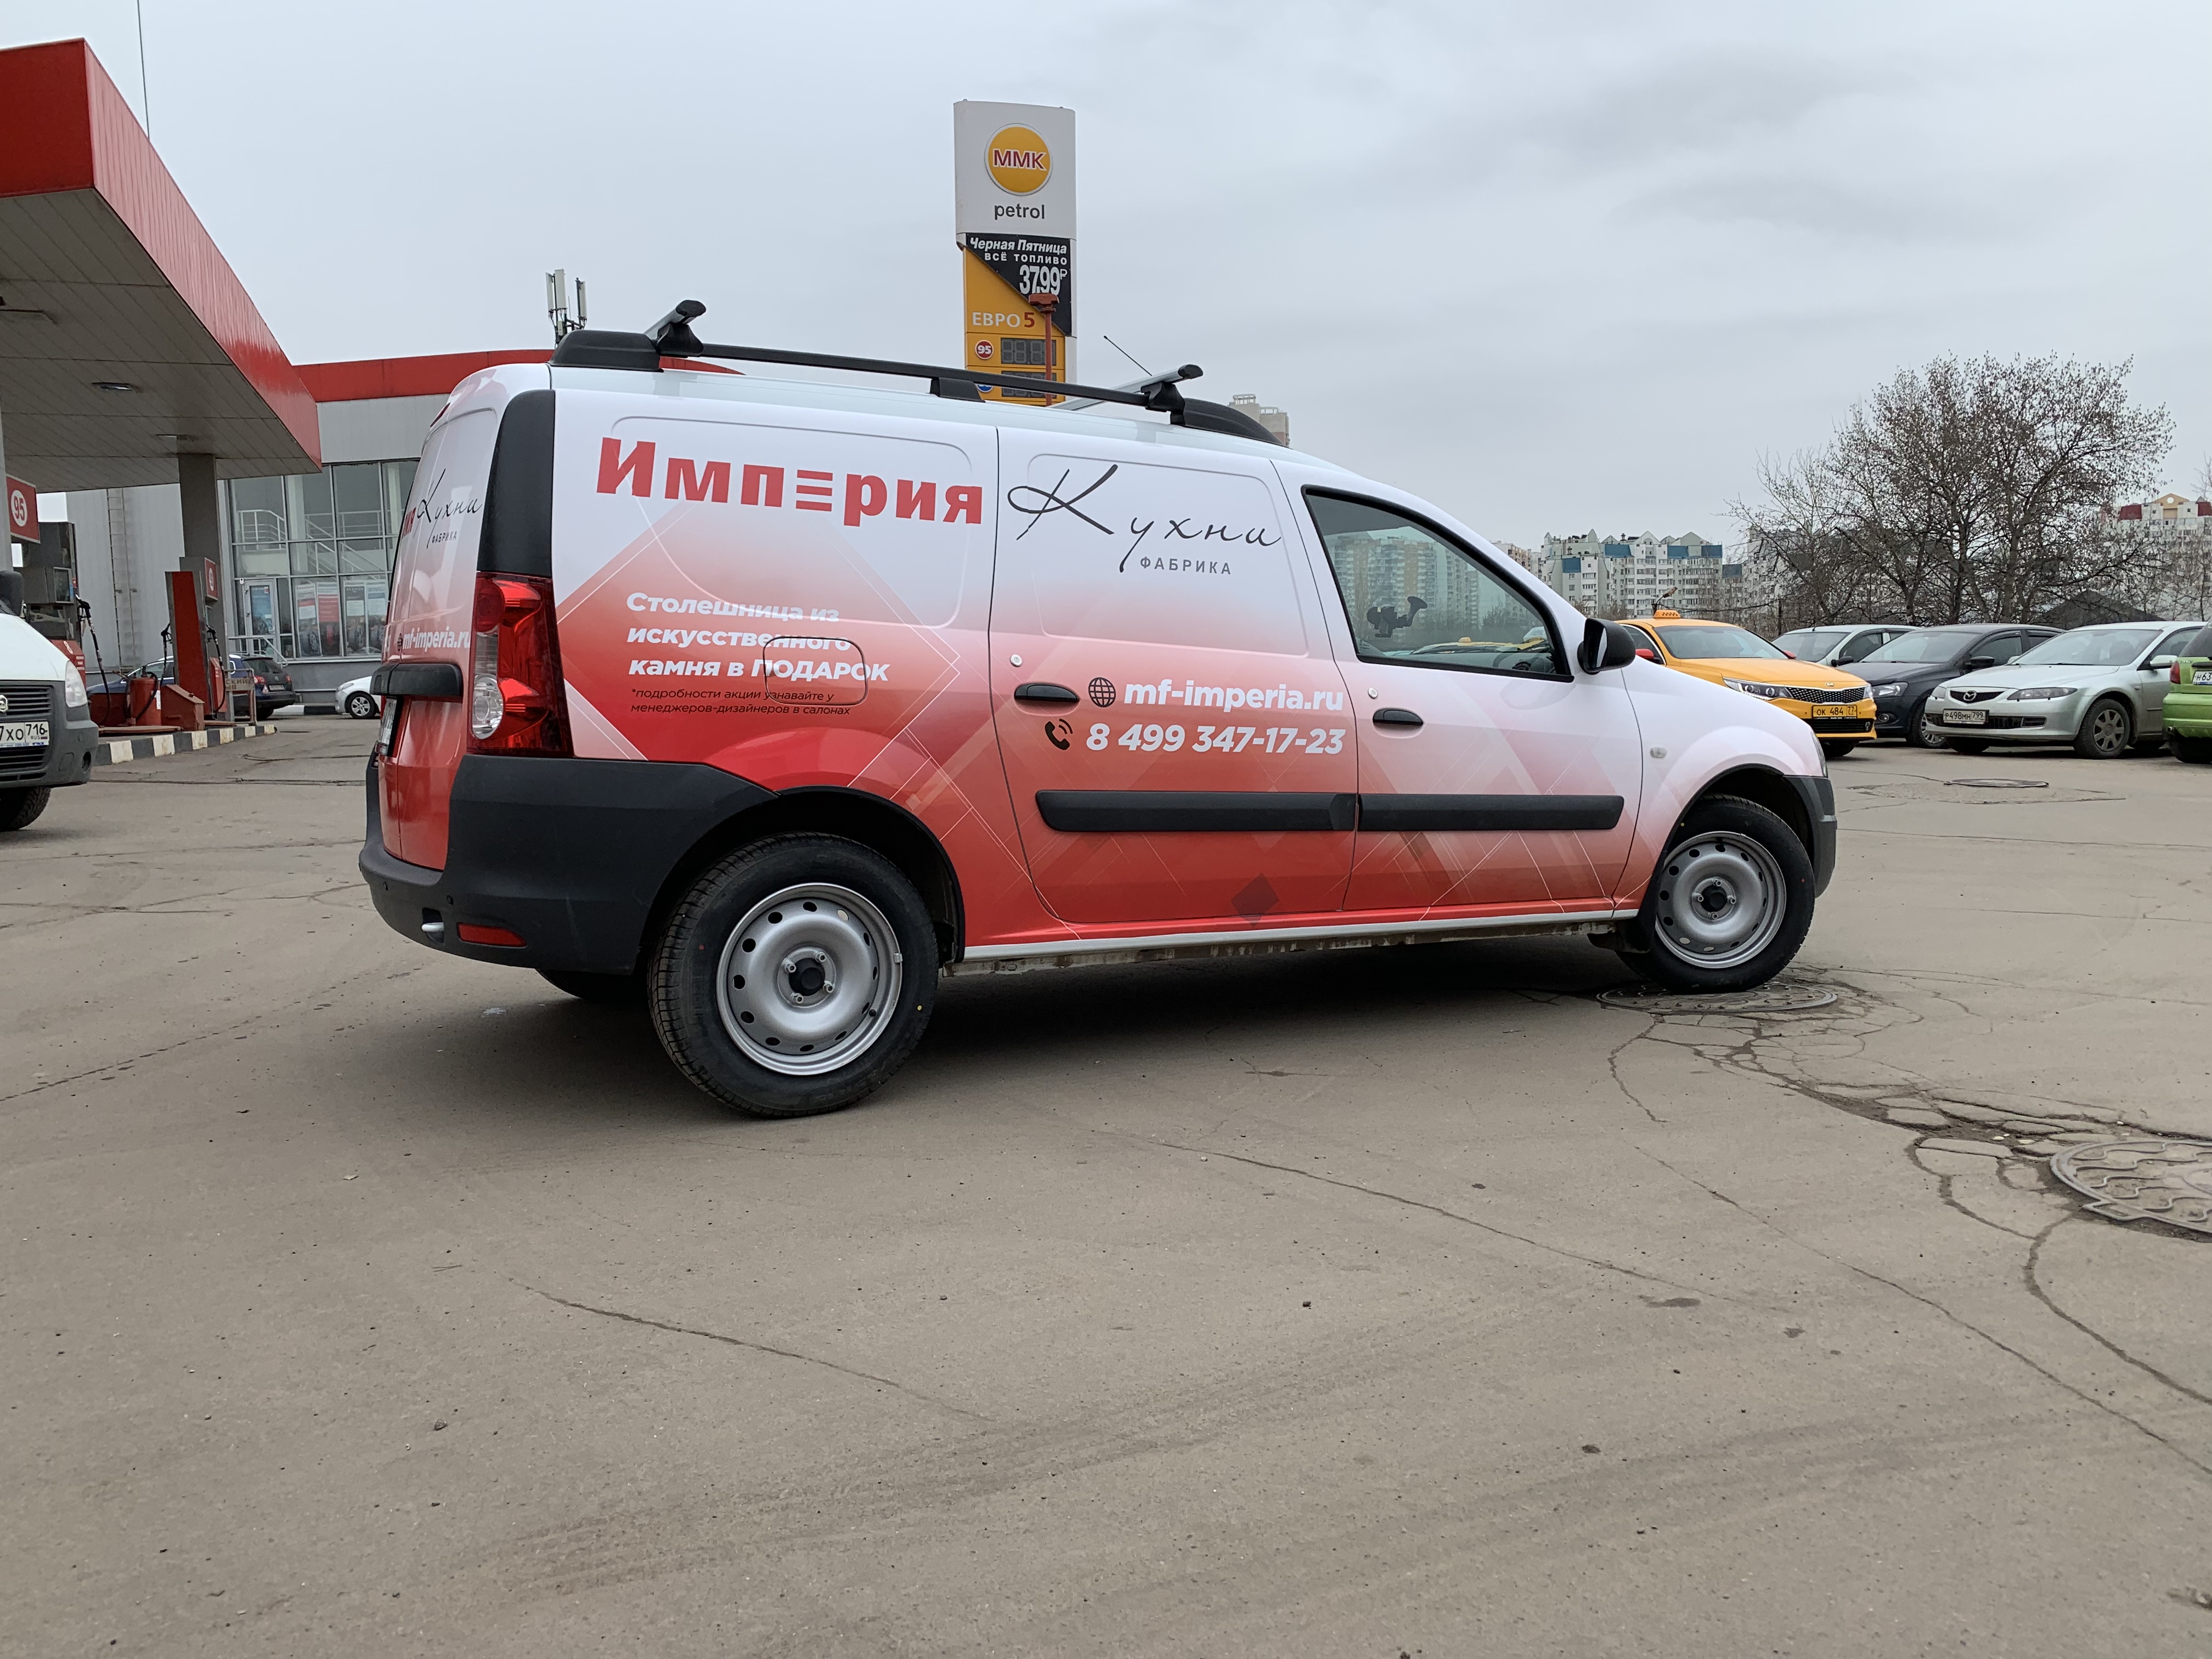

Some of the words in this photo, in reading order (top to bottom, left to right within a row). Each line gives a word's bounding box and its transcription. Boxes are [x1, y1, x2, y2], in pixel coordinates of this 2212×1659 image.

[994, 202, 1045, 220] petrol
[970, 237, 1015, 251] Черная
[1017, 239, 1067, 255] Пятница
[972, 312, 1021, 328] ЕВРО
[1024, 312, 1035, 328] 5
[977, 345, 992, 354] 95
[14, 495, 25, 521] 95
[432, 531, 457, 544] ФАБРИКА
[1139, 556, 1232, 575] ФАБРИКА
[627, 592, 803, 622] Столешница
[810, 608, 839, 622] из
[403, 626, 471, 652] mf-imperia.ru
[627, 628, 851, 651] искусственного
[629, 660, 721, 676] камня
[727, 662, 744, 676] в
[751, 659, 891, 682] ПОДАРОК
[724, 691, 761, 700] акции
[763, 691, 824, 701] узнавайте
[826, 693, 834, 702] у
[1124, 679, 1344, 713] mf-imperia.ru
[631, 703, 789, 714] менеджеров-дизайнеров
[803, 707, 851, 715] салонах
[1830, 707, 1844, 715] 484
[26, 723, 46, 735] 716
[1086, 723, 1111, 751] 8
[1118, 723, 1186, 752] 499
[1192, 725, 1346, 755] 347-17-23
